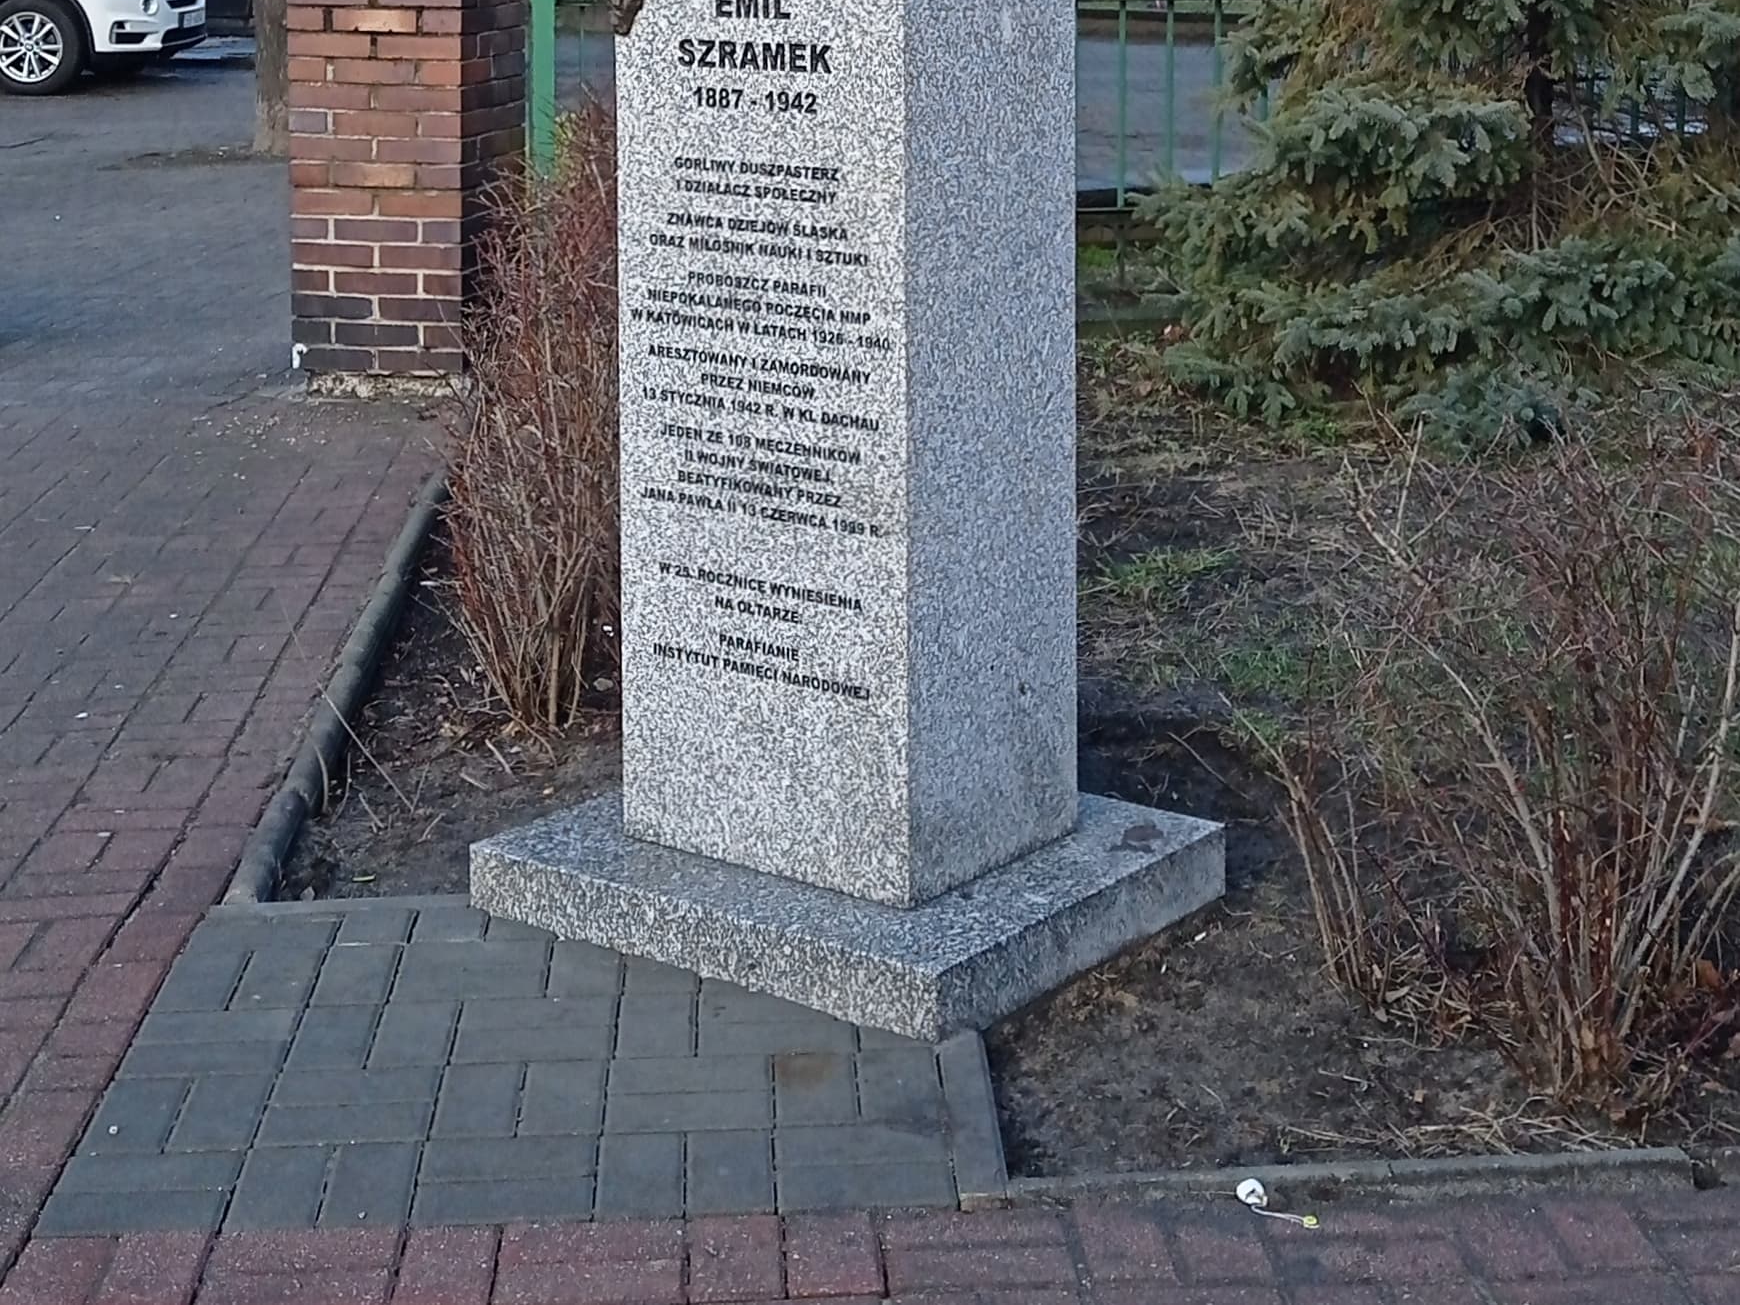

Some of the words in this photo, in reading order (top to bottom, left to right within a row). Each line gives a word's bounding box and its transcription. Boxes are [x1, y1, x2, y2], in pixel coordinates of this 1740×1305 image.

[678, 39, 832, 75] SZRAMEK
[693, 87, 744, 111] 1887
[765, 90, 817, 115] 1942
[674, 157, 735, 173] GORLIWY
[740, 162, 839, 182] DUSZPASTERZ
[685, 180, 751, 197] DZIAŁACZ
[755, 186, 837, 204] SPOŁECZNY
[667, 213, 723, 229] ZNAWCA
[650, 234, 684, 248] ORAZ
[759, 245, 802, 261] NAUKI
[816, 249, 868, 266] SZTUKI
[688, 271, 769, 292] PROBOSZCZ
[773, 280, 827, 297] PARAFII
[648, 289, 762, 313] NIEPOKALANEGO
[840, 310, 871, 325] NMP
[631, 308, 643, 321] W
[647, 309, 734, 332] KATOWICACH
[737, 320, 750, 334] W
[754, 322, 807, 341] LATACH
[812, 329, 844, 345] 1926
[856, 335, 890, 351] 1940
[648, 344, 747, 368] ARESZTOWANY
[761, 359, 871, 384] ZAMORDOWANY
[701, 373, 744, 390] PRZEZ
[642, 386, 656, 400] 13
[660, 389, 726, 410] STYCZNIA
[731, 399, 761, 414] 1942
[782, 406, 795, 419] W
[799, 409, 817, 423] KL
[821, 412, 879, 432] DACHAU
[660, 424, 702, 441] JEDEN
[707, 430, 723, 444] ZE
[728, 434, 751, 448] 108
[685, 449, 694, 462] II
[698, 451, 745, 469] WOJNY
[678, 470, 793, 499] BEATYFIKOWANY
[797, 489, 841, 508] PRZEZ
[640, 487, 675, 503] JANA
[679, 492, 724, 511] PAWŁA
[728, 500, 736, 513] II
[742, 503, 756, 517] 13
[761, 506, 826, 529] CZERWCA
[659, 562, 671, 575] W
[698, 568, 767, 594] ROCZNICĘ
[770, 582, 863, 612] WYNIESIENIA
[714, 596, 734, 611] NA
[719, 634, 799, 662] PARAFIANIE
[653, 643, 720, 669] INSTYTUT
[723, 658, 778, 682] PAMIĘCI
[782, 670, 870, 700] NARODOWEJ
